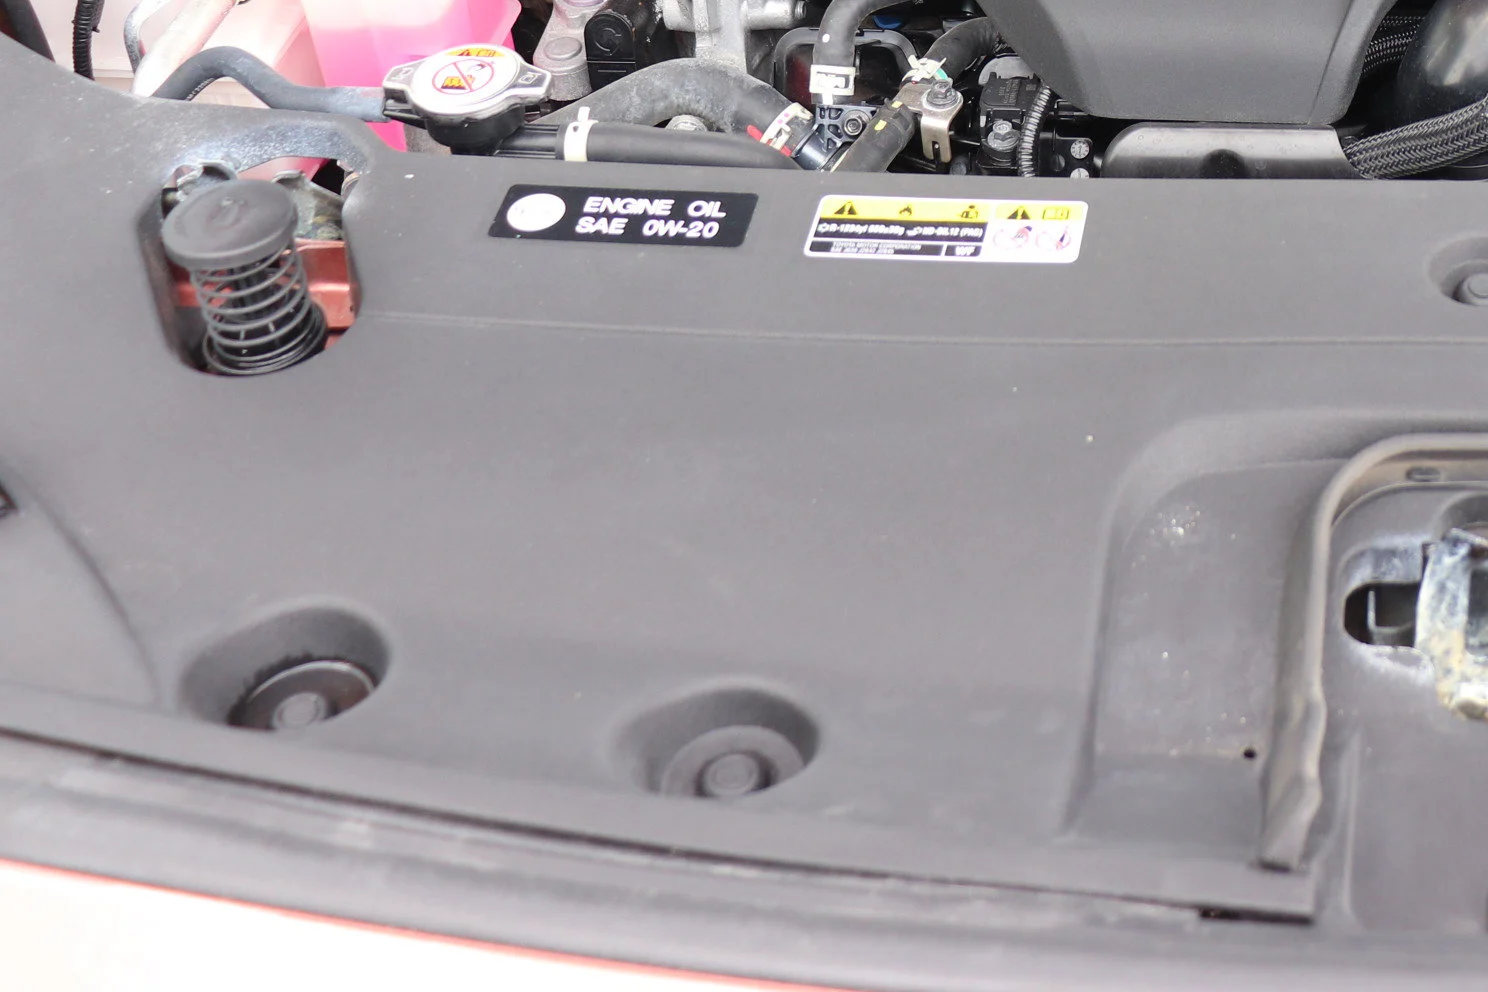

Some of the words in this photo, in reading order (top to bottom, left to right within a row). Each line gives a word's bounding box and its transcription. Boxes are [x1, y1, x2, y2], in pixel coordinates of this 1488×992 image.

[582, 196, 675, 217] ENGINE
[686, 199, 727, 218] OIL
[574, 216, 629, 236] SAE
[641, 219, 720, 239] 0W-20
